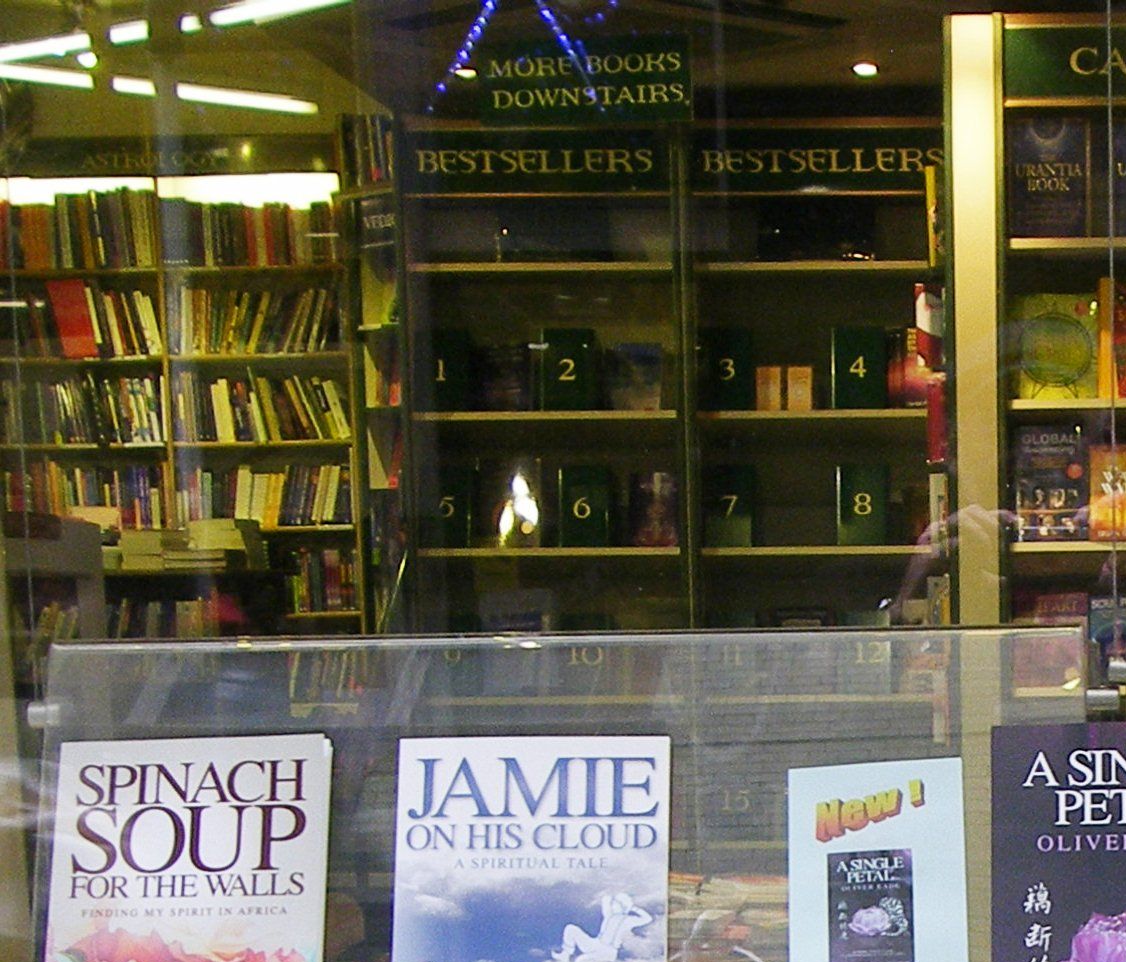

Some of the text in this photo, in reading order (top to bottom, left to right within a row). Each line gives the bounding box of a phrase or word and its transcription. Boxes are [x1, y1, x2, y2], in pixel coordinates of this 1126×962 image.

[487, 51, 681, 79] MORE BOOKS
[416, 149, 653, 175] BESTSELLERS
[703, 147, 945, 173] BESTSELLERS
[435, 360, 446, 381] 1
[558, 359, 577, 381] 2
[719, 359, 736, 380] 3
[849, 357, 867, 379] 4
[1022, 434, 1077, 446] GLOBAL
[573, 497, 591, 519] 6
[854, 493, 872, 515] 8
[1022, 751, 1060, 787] A
[76, 759, 308, 806] SPINACH
[407, 757, 660, 820] JAMIE
[815, 788, 903, 843] New
[71, 804, 306, 874] SOUP
[406, 823, 657, 850] ON HIS CLOUD
[471, 857, 607, 868] SPIRITUAL TALE
[850, 857, 904, 870] SINGLE
[70, 872, 304, 899] FOR THE WALLS
[847, 870, 896, 883] PETAL
[170, 905, 287, 917] SPIRIT AFRICA
